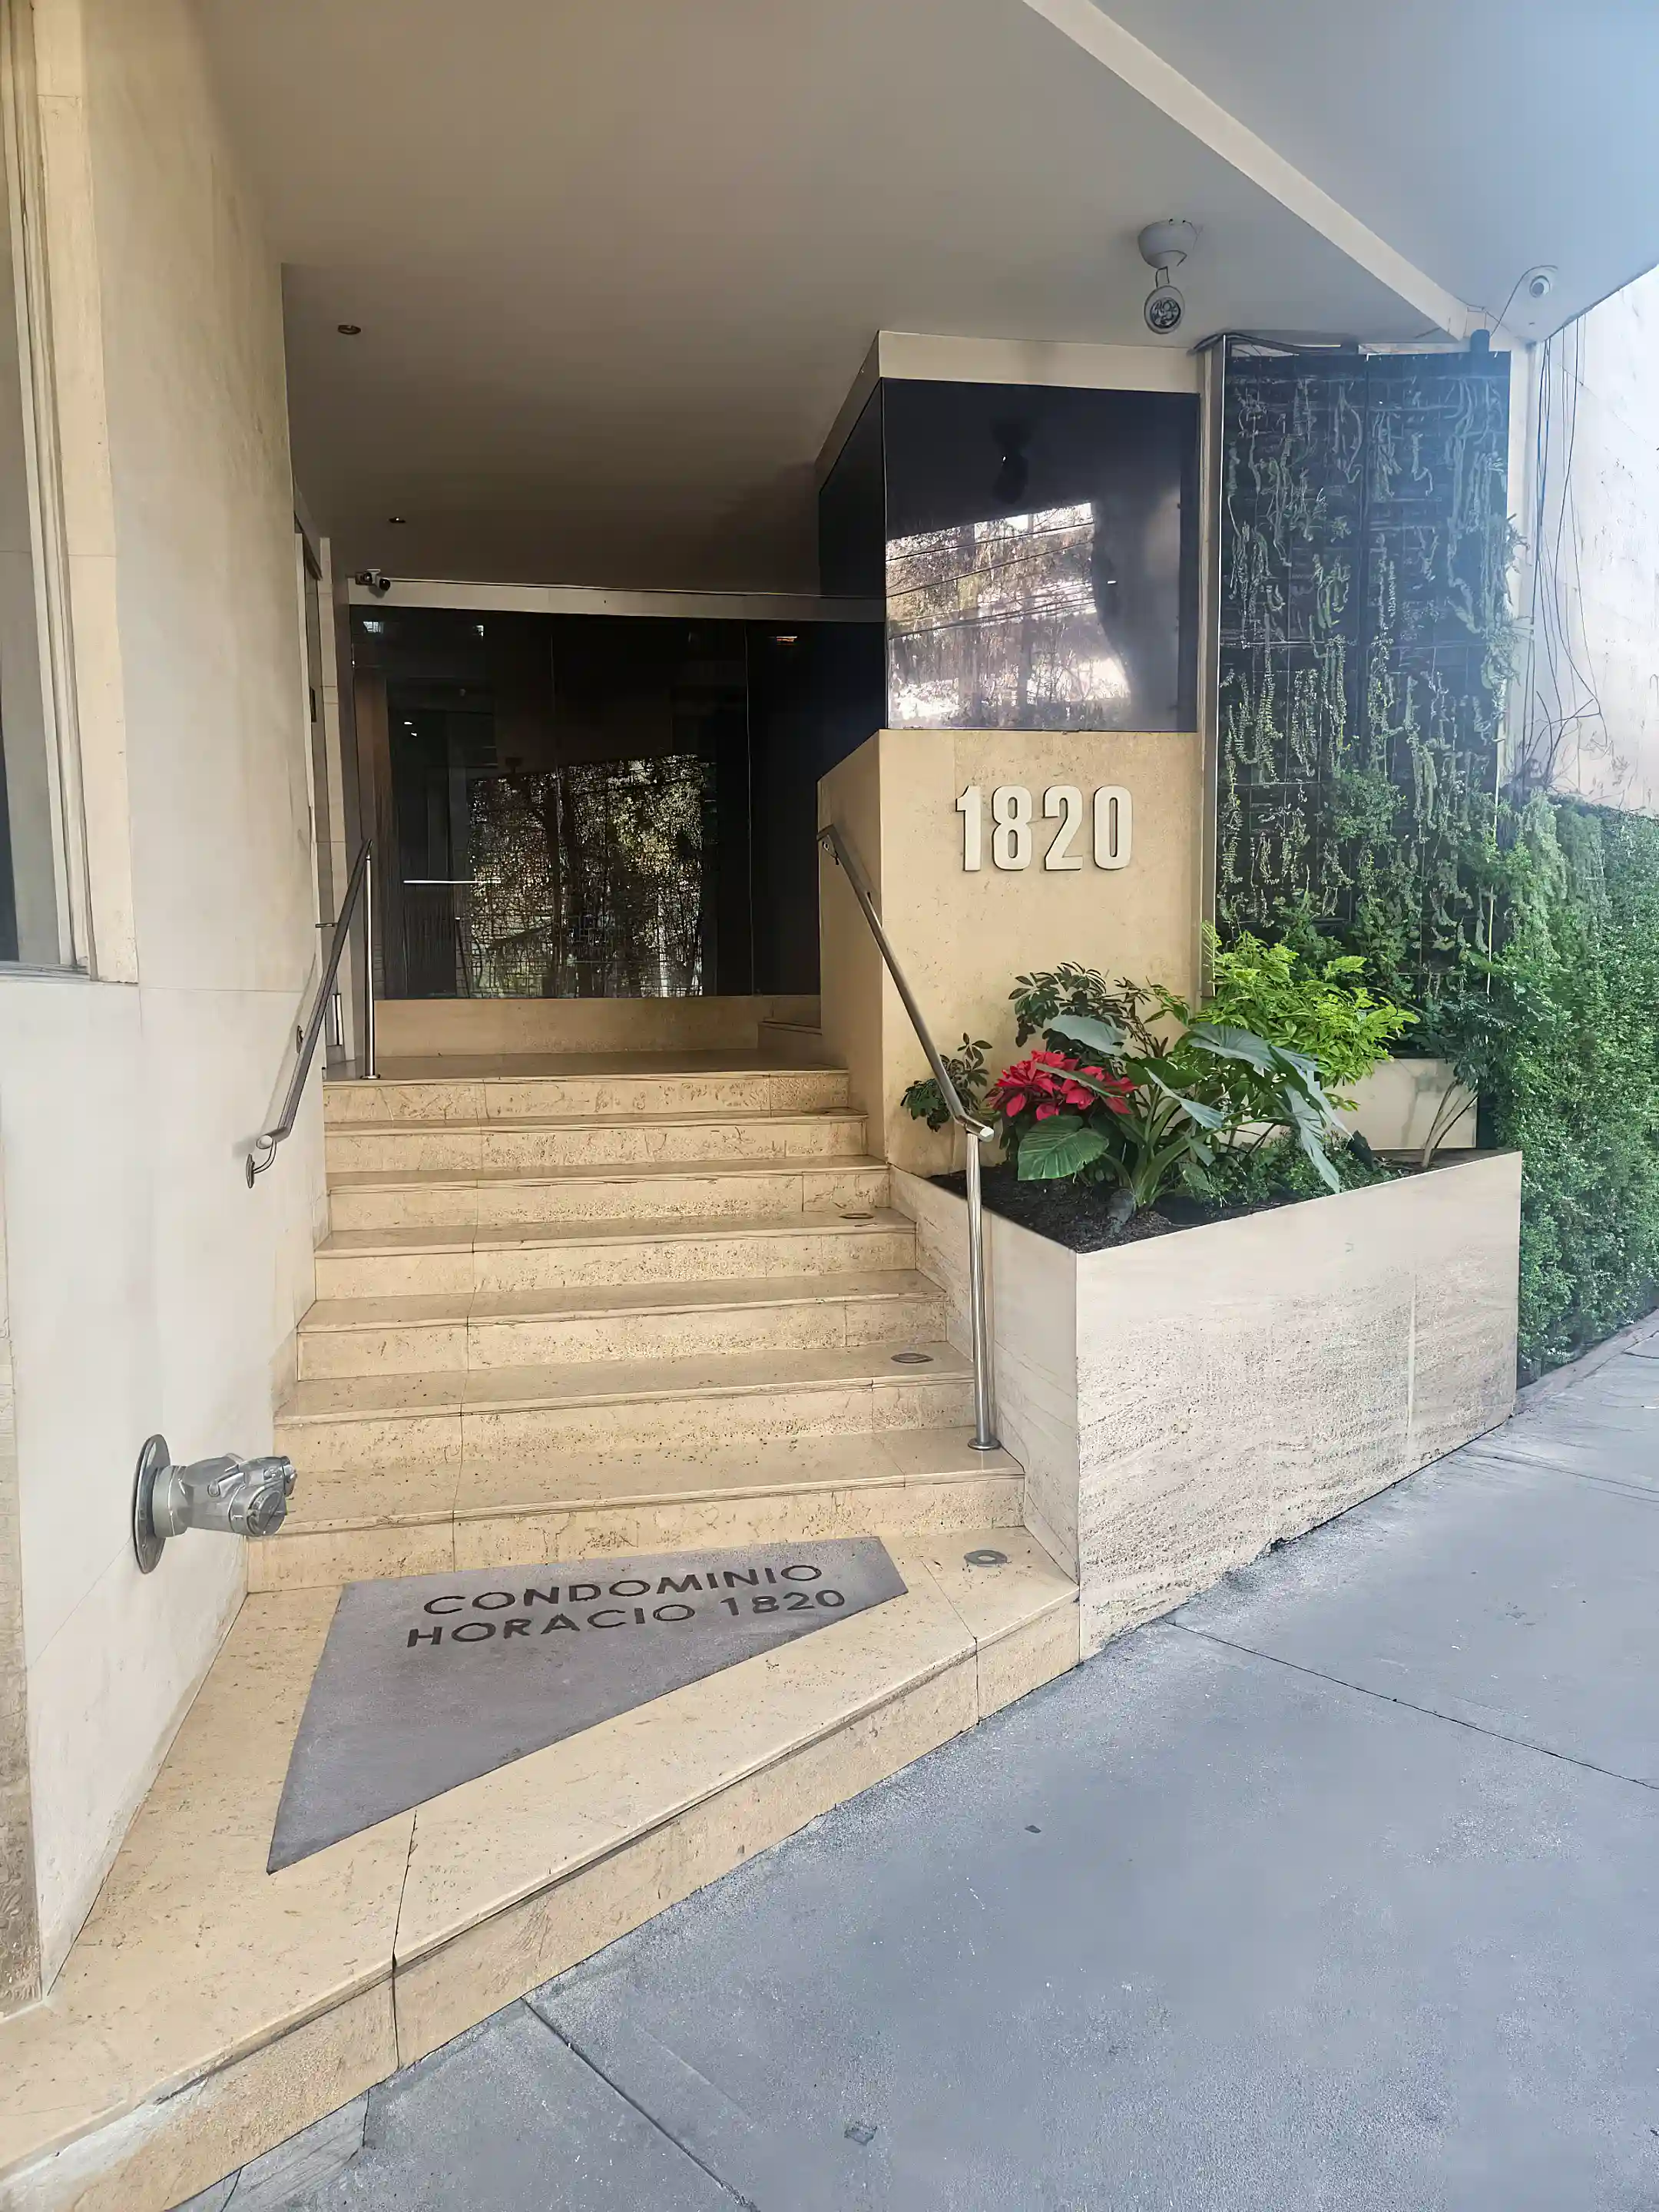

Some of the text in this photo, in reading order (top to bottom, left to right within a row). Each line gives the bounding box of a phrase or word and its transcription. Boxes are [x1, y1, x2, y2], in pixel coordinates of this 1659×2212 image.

[955, 784, 1133, 871] 1820
[406, 1589, 846, 1647] HORACIO 1820
[423, 1564, 823, 1614] CONDOMINIO
